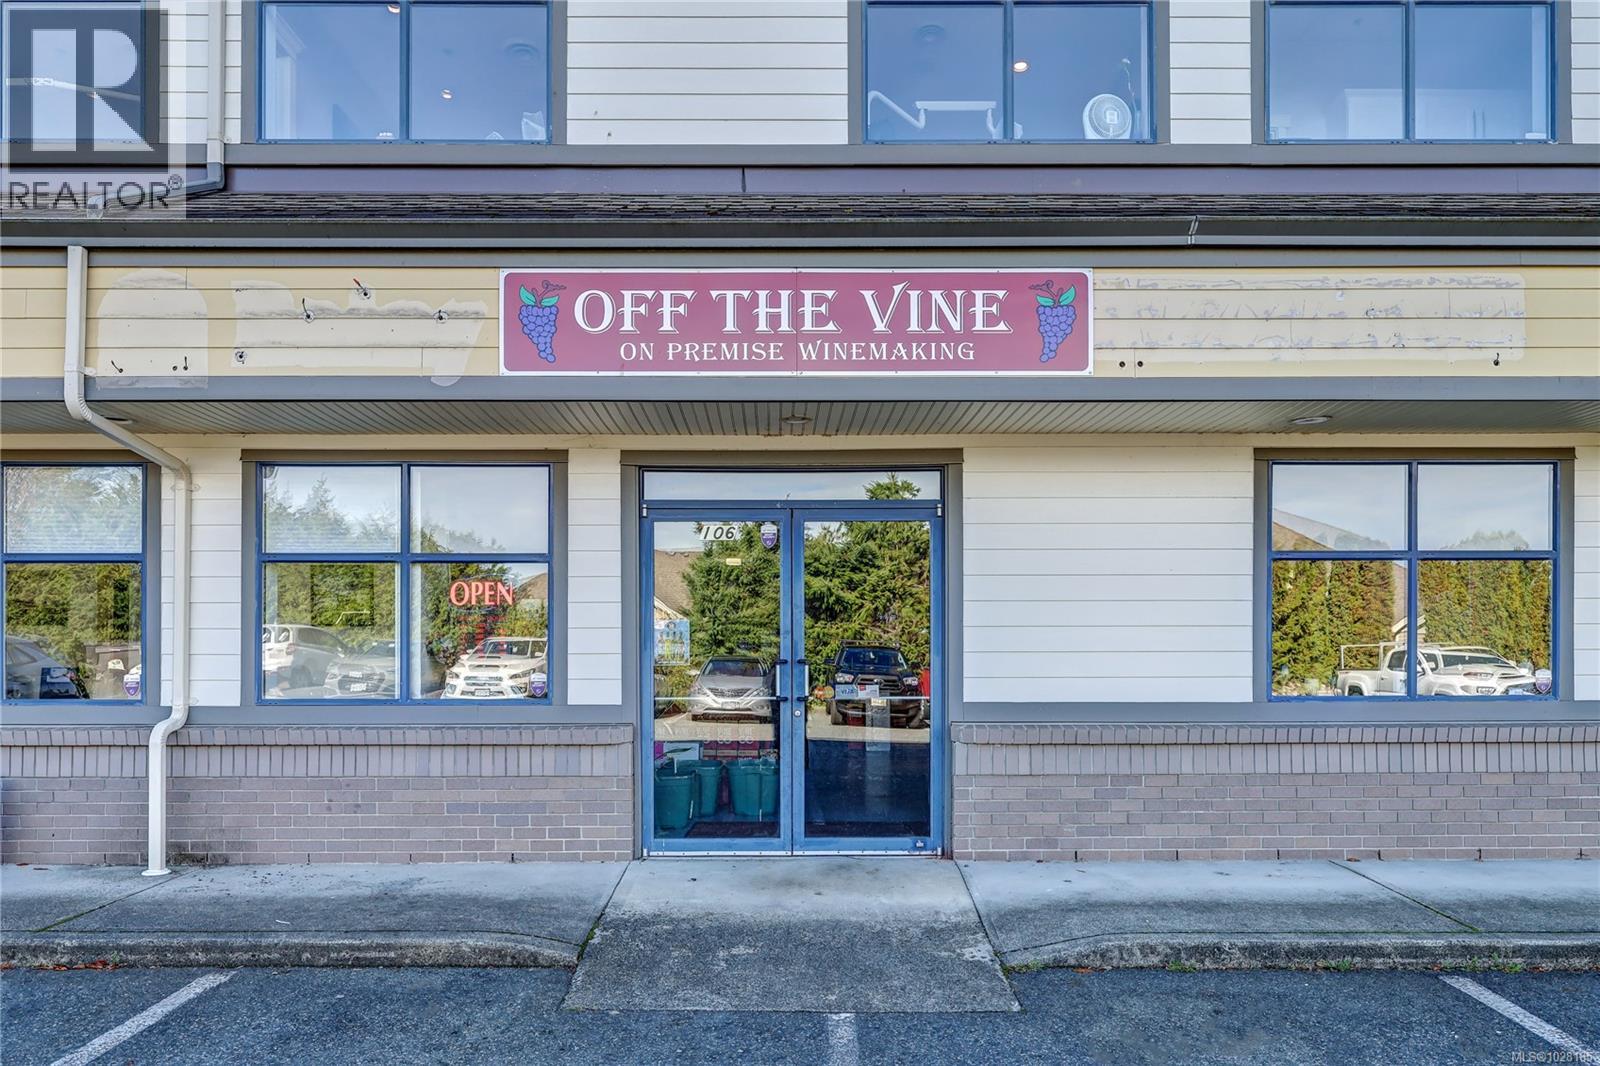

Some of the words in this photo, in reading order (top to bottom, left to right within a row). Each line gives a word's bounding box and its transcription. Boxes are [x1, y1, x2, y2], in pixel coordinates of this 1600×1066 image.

[574, 289, 698, 334] OFF
[709, 289, 843, 334] THE
[859, 280, 1014, 334] VINE
[620, 342, 655, 361] ON
[667, 342, 785, 362] PREMISE
[798, 339, 976, 361] WINEMAKING
[703, 526, 736, 540] 106
[450, 581, 513, 606] OPEN
